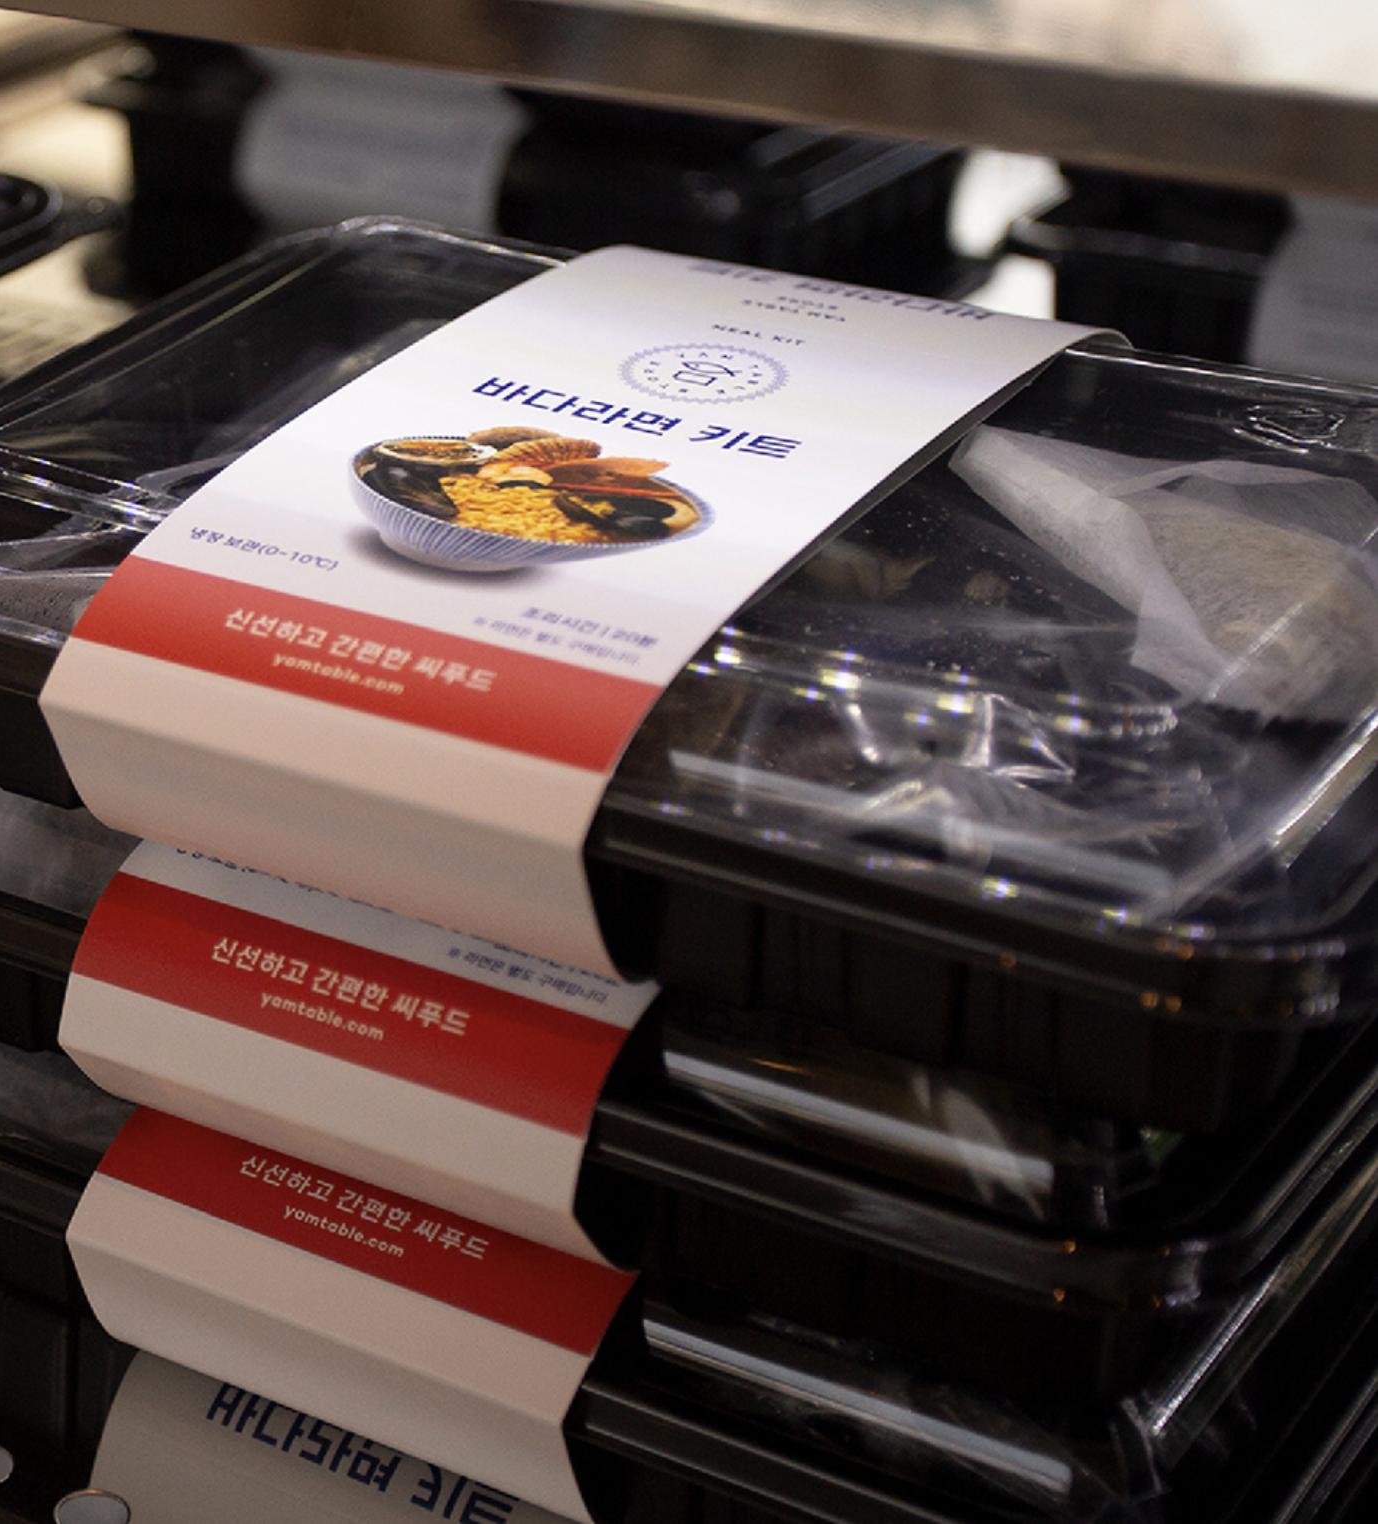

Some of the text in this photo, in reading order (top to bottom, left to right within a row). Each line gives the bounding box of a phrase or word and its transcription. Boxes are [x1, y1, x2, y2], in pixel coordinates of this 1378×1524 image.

[472, 376, 802, 459] 바다라면 키트
[225, 607, 498, 693] 신선하고 간편한 씨푸드
[271, 652, 406, 696] yamtable.com
[211, 937, 471, 1037] 신선하고 간편한 씨푸드
[260, 990, 385, 1042] yamtable.com
[238, 1155, 490, 1262] 신선하고 간편한 씨푸드
[282, 1204, 405, 1259] yamtable.com
